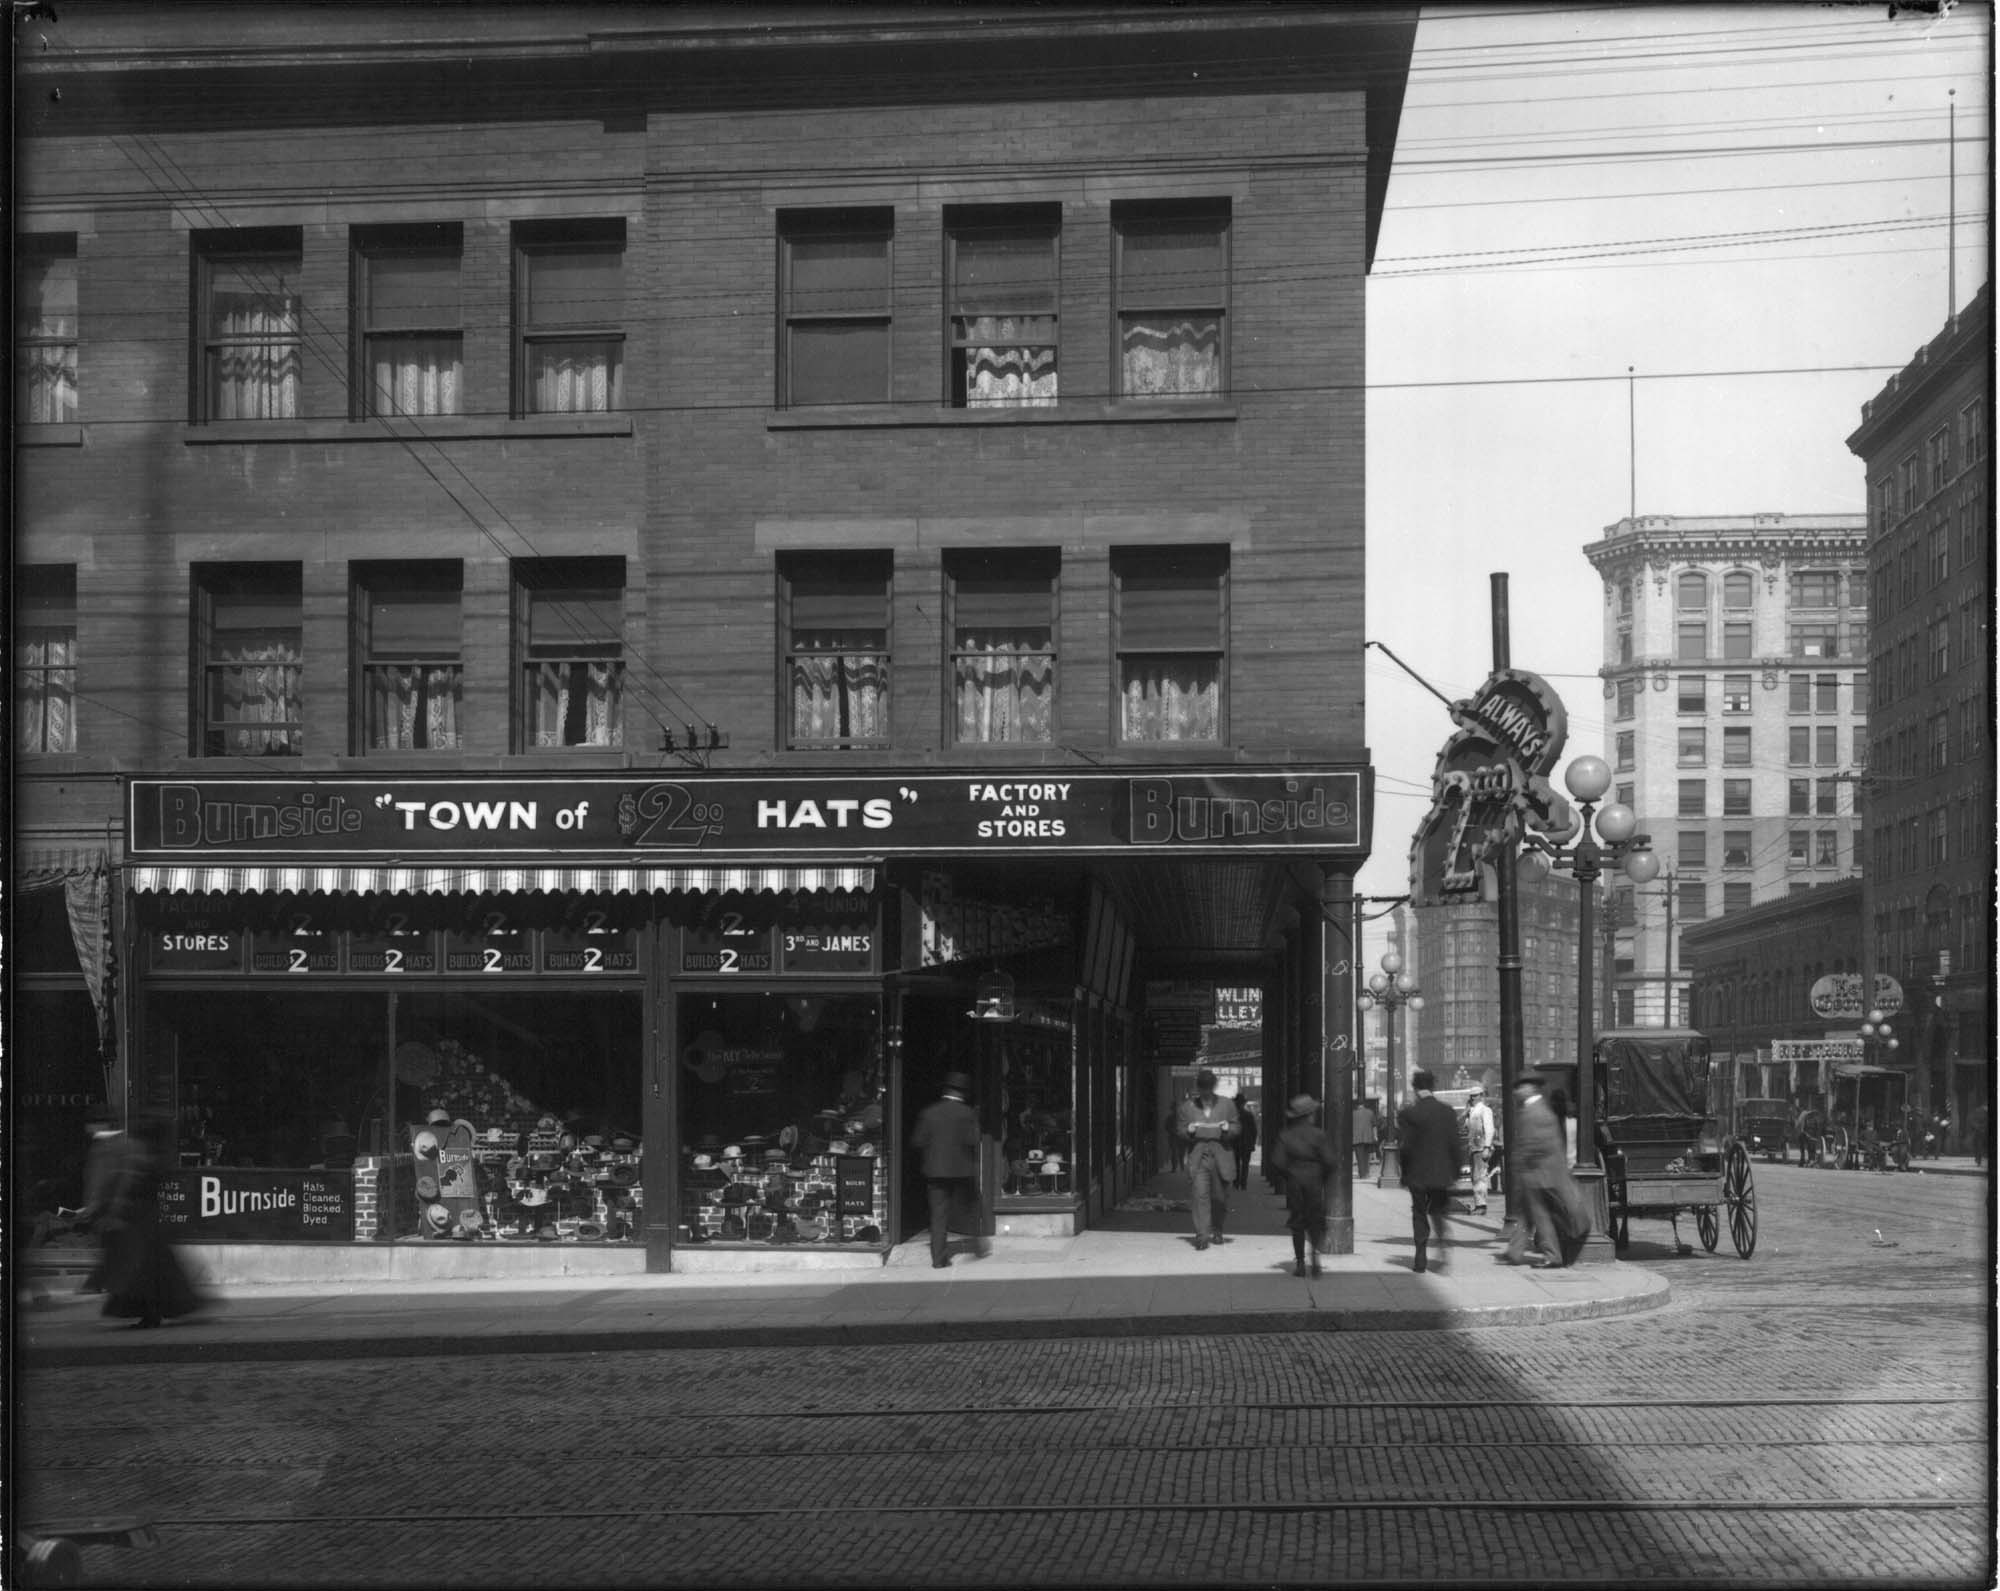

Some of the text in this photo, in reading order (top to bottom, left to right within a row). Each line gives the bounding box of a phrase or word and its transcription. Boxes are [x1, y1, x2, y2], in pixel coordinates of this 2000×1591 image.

[1479, 694, 1544, 757] ALWAYS
[969, 783, 1071, 802] FACTORY
[160, 785, 363, 848] Burnside
[555, 801, 589, 830] of
[1001, 804, 1040, 817] AND
[1130, 778, 1352, 844] Burnside
[977, 820, 1066, 838] STORES
[824, 896, 869, 913] UNION
[161, 934, 231, 952] STORES
[805, 938, 820, 948] AND
[821, 935, 871, 952] JAMES
[310, 953, 337, 969] HATS
[406, 953, 433, 968] HATS
[449, 953, 482, 968] BUILDS
[504, 953, 532, 968] HATS
[604, 953, 633, 968] HATS
[686, 954, 719, 969] BUILDS
[740, 953, 769, 969] HATS
[1216, 987, 1262, 1002] WLIN
[1216, 1005, 1259, 1019] LLEY
[303, 1181, 325, 1192] Hats
[157, 1191, 185, 1201] Made
[201, 1175, 296, 1217] Burnside
